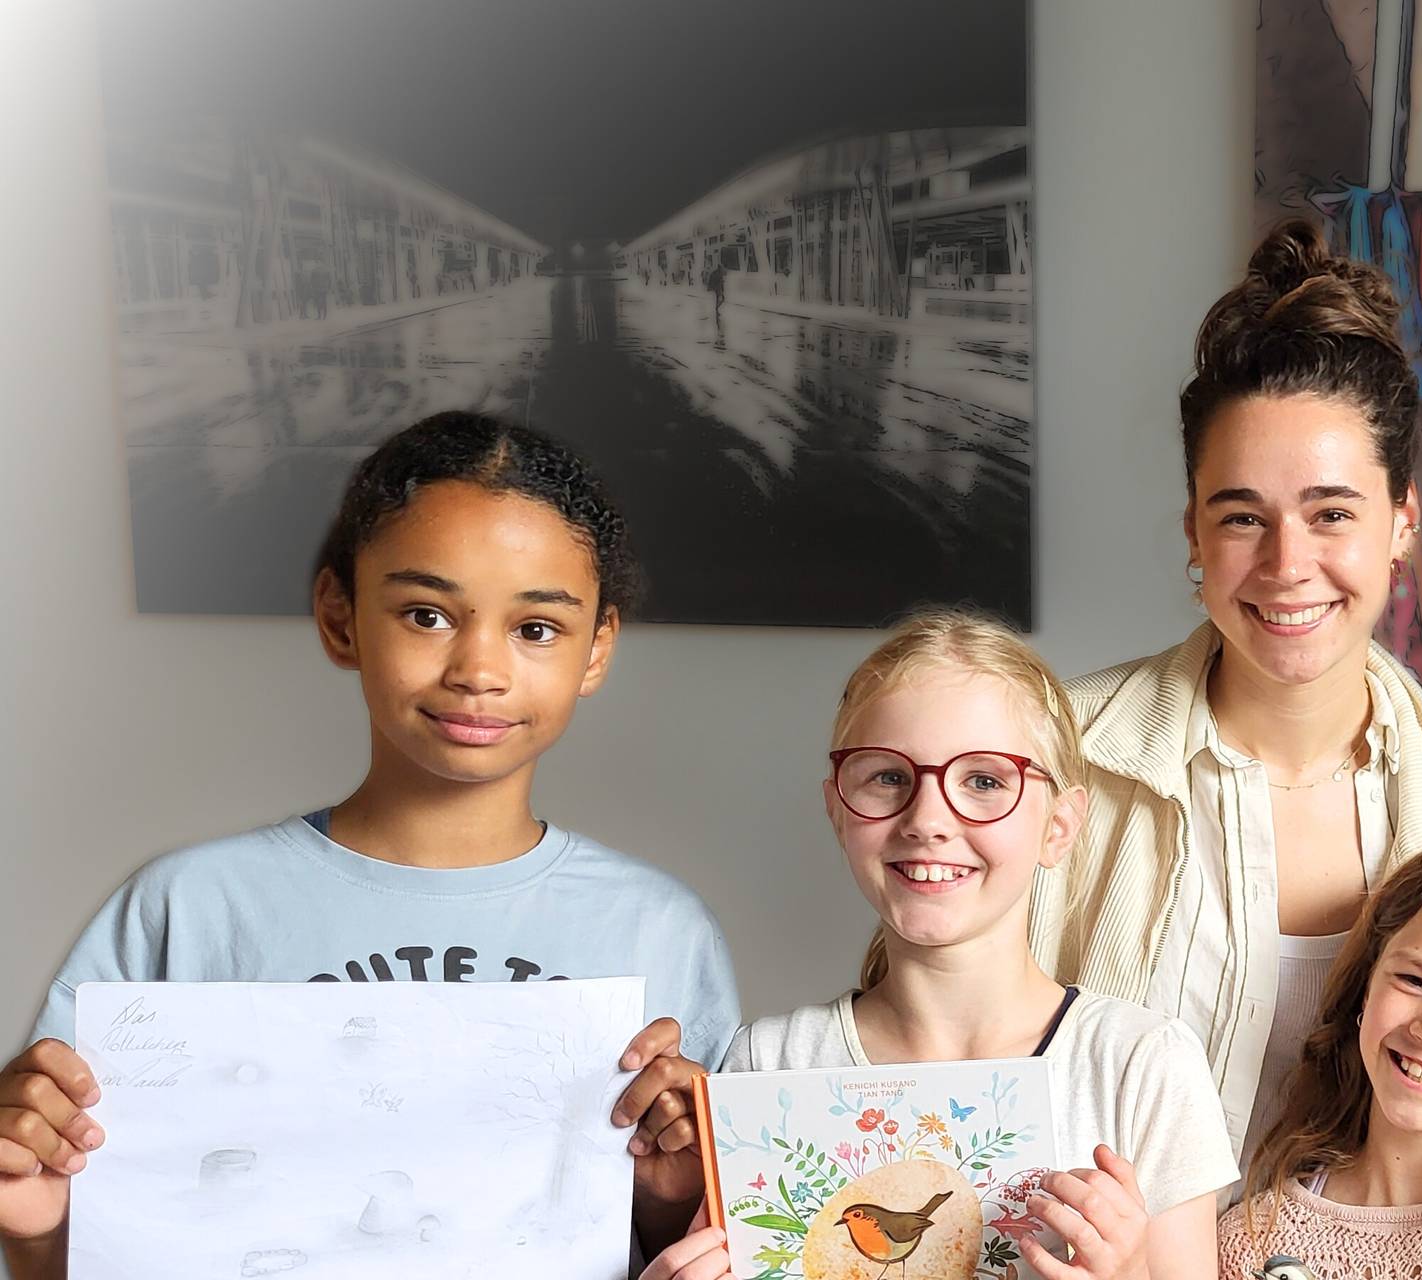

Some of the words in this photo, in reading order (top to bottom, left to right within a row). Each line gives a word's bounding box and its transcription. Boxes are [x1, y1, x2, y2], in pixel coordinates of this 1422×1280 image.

[307, 947, 477, 982] UTE
[505, 956, 573, 982] T
[843, 1082, 878, 1090] KENICHI
[881, 1080, 917, 1088] KUSANO
[858, 1090, 878, 1098] TIAN
[880, 1089, 904, 1097] TANG
